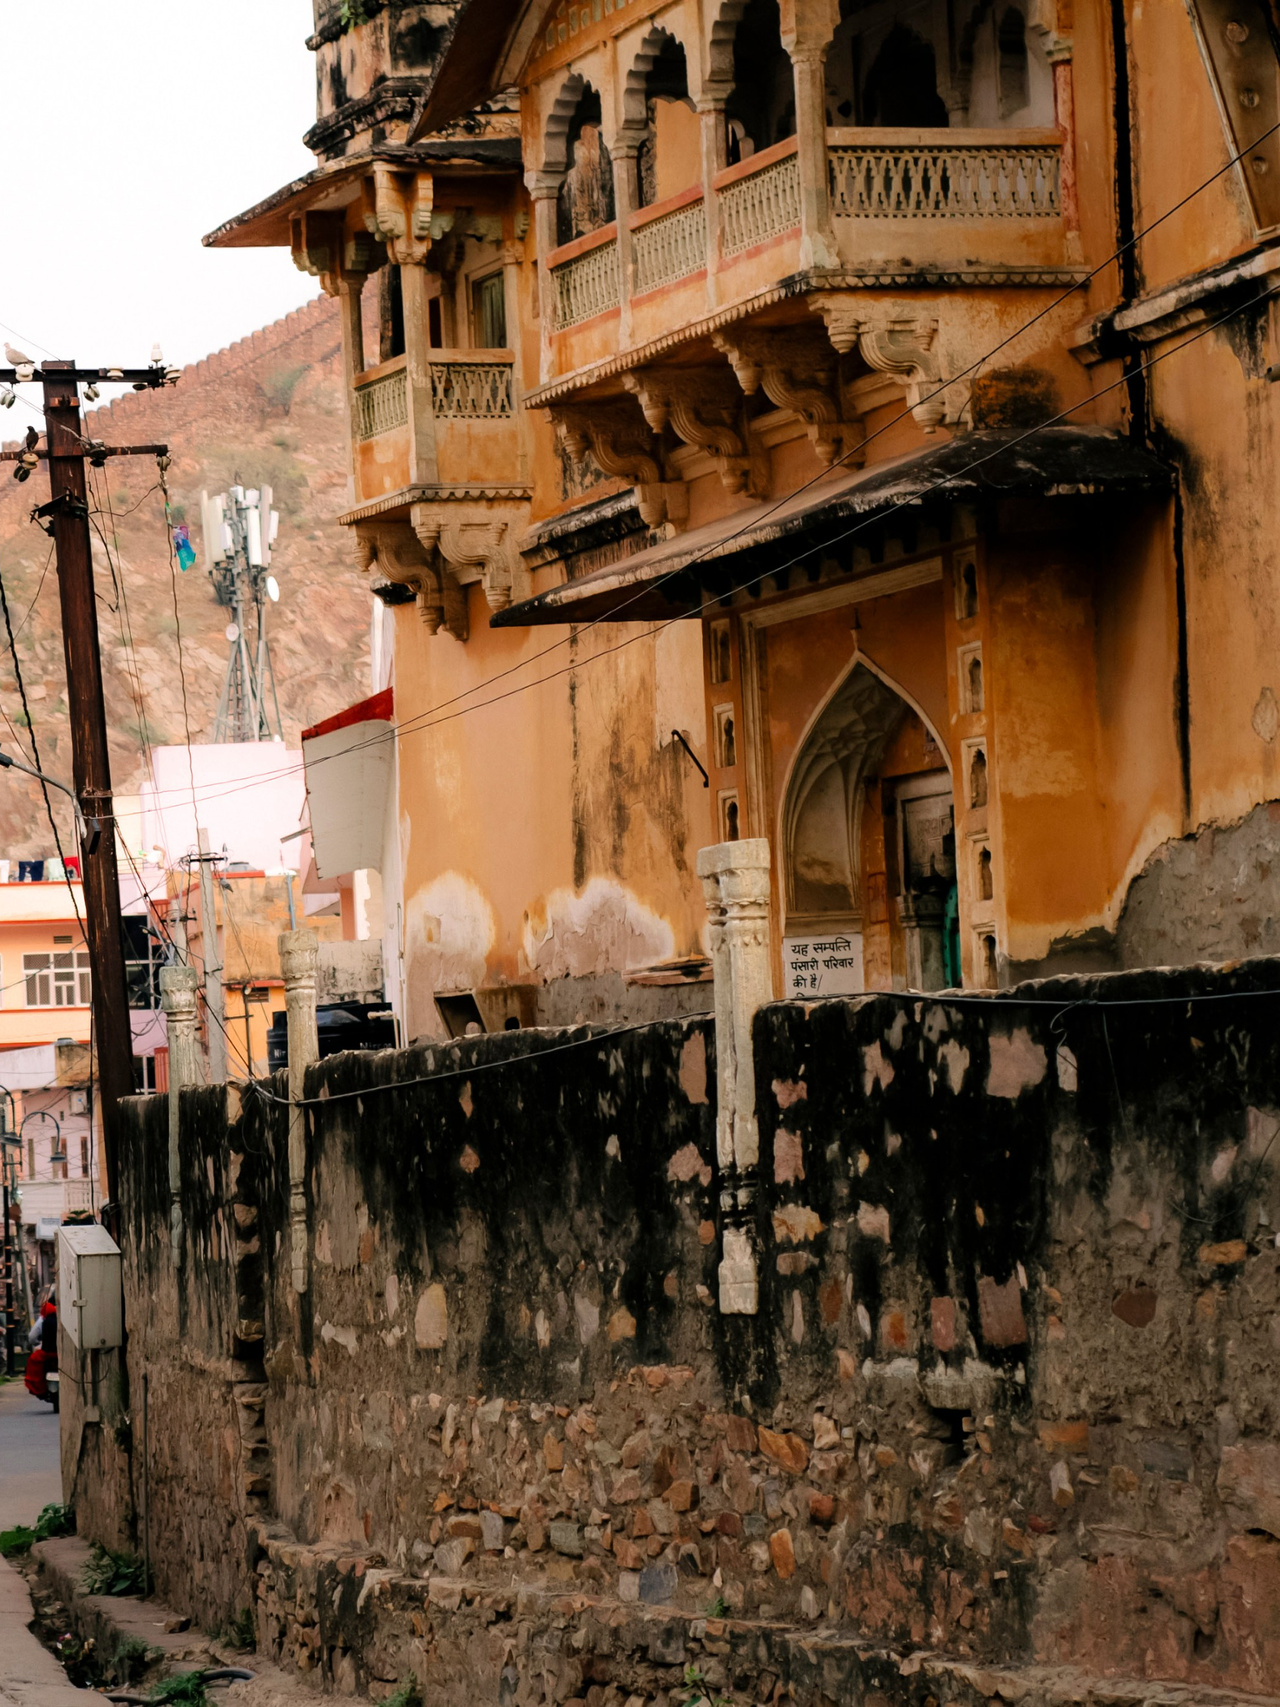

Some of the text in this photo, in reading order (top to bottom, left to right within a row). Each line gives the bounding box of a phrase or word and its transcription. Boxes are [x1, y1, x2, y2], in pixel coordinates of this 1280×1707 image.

[791, 944, 809, 956] यह
[791, 956, 854, 972] पंसारी परिवार
[792, 974, 807, 988] की
